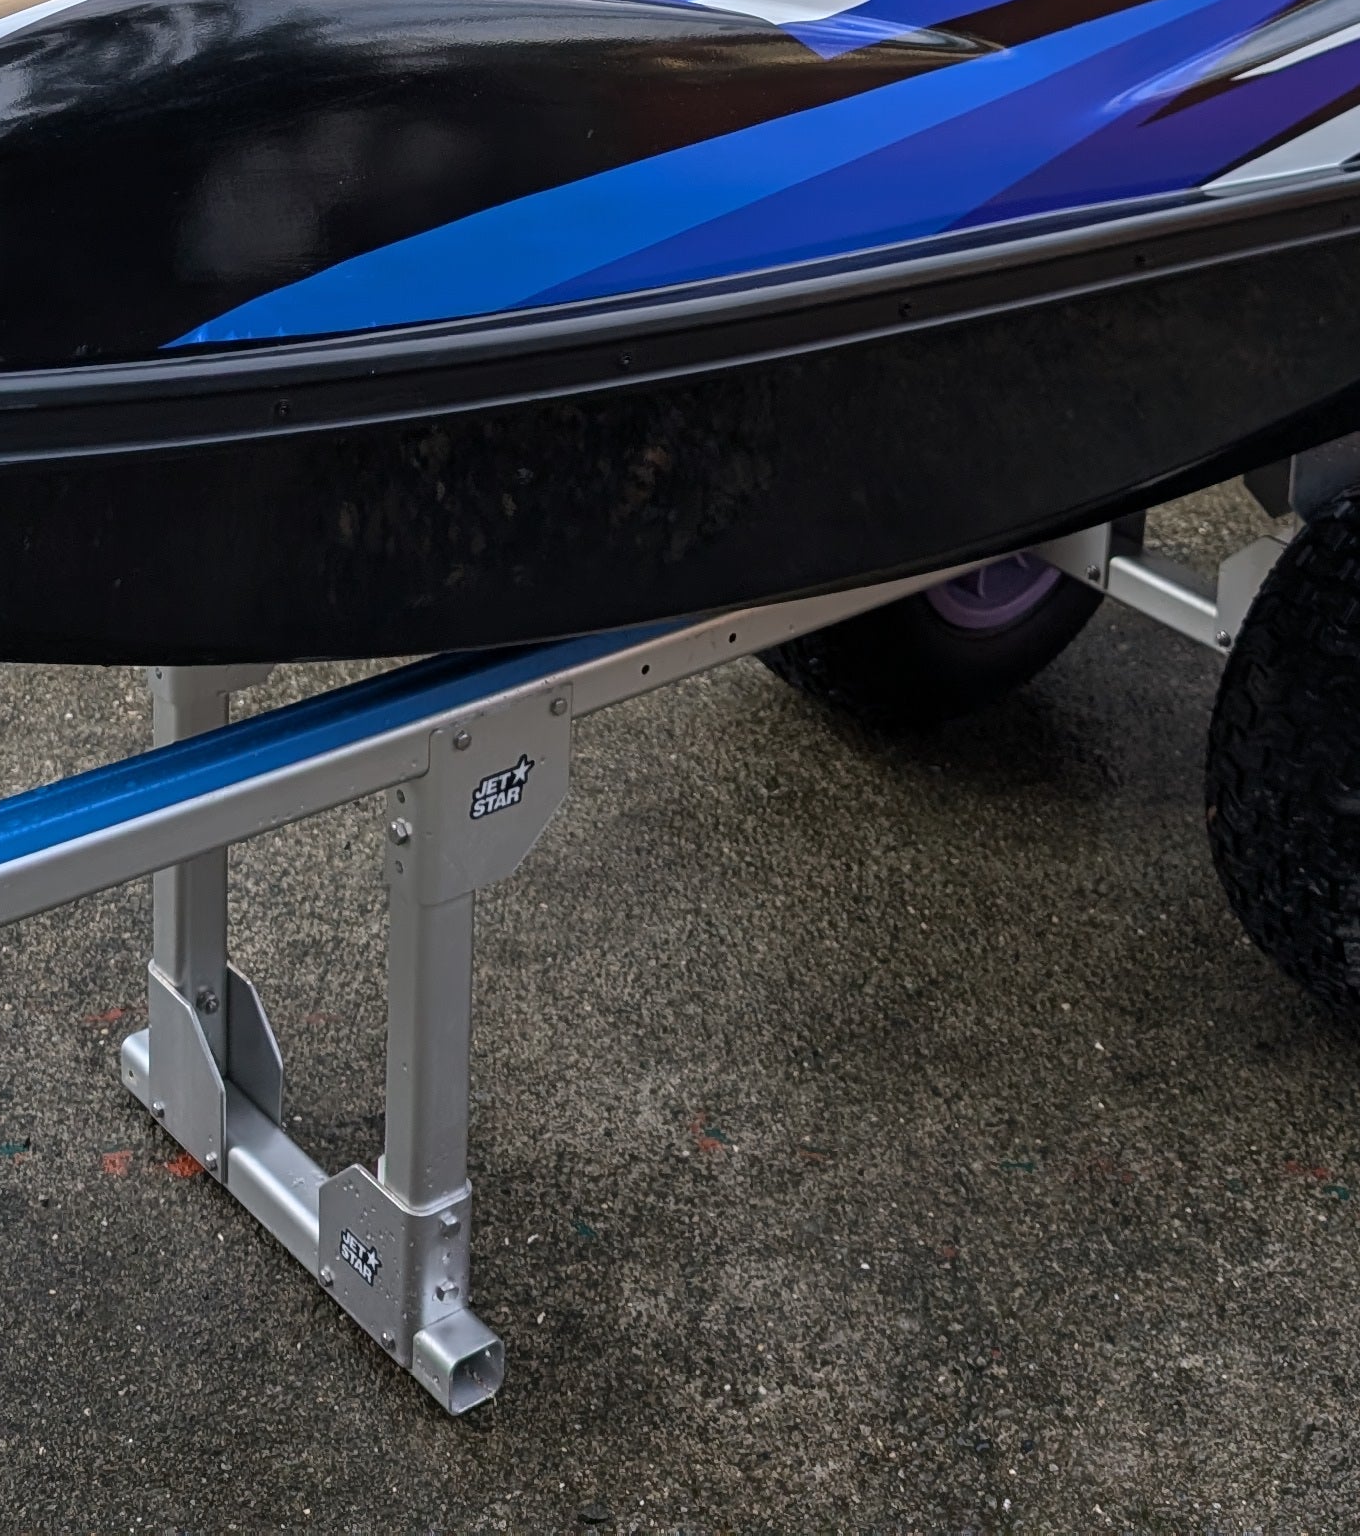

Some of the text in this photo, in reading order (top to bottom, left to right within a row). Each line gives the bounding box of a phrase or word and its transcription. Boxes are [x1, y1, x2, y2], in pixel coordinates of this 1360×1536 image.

[475, 771, 512, 799] JET
[472, 785, 521, 818] STAR
[342, 1231, 367, 1259] JET
[341, 1243, 372, 1284] STAR
